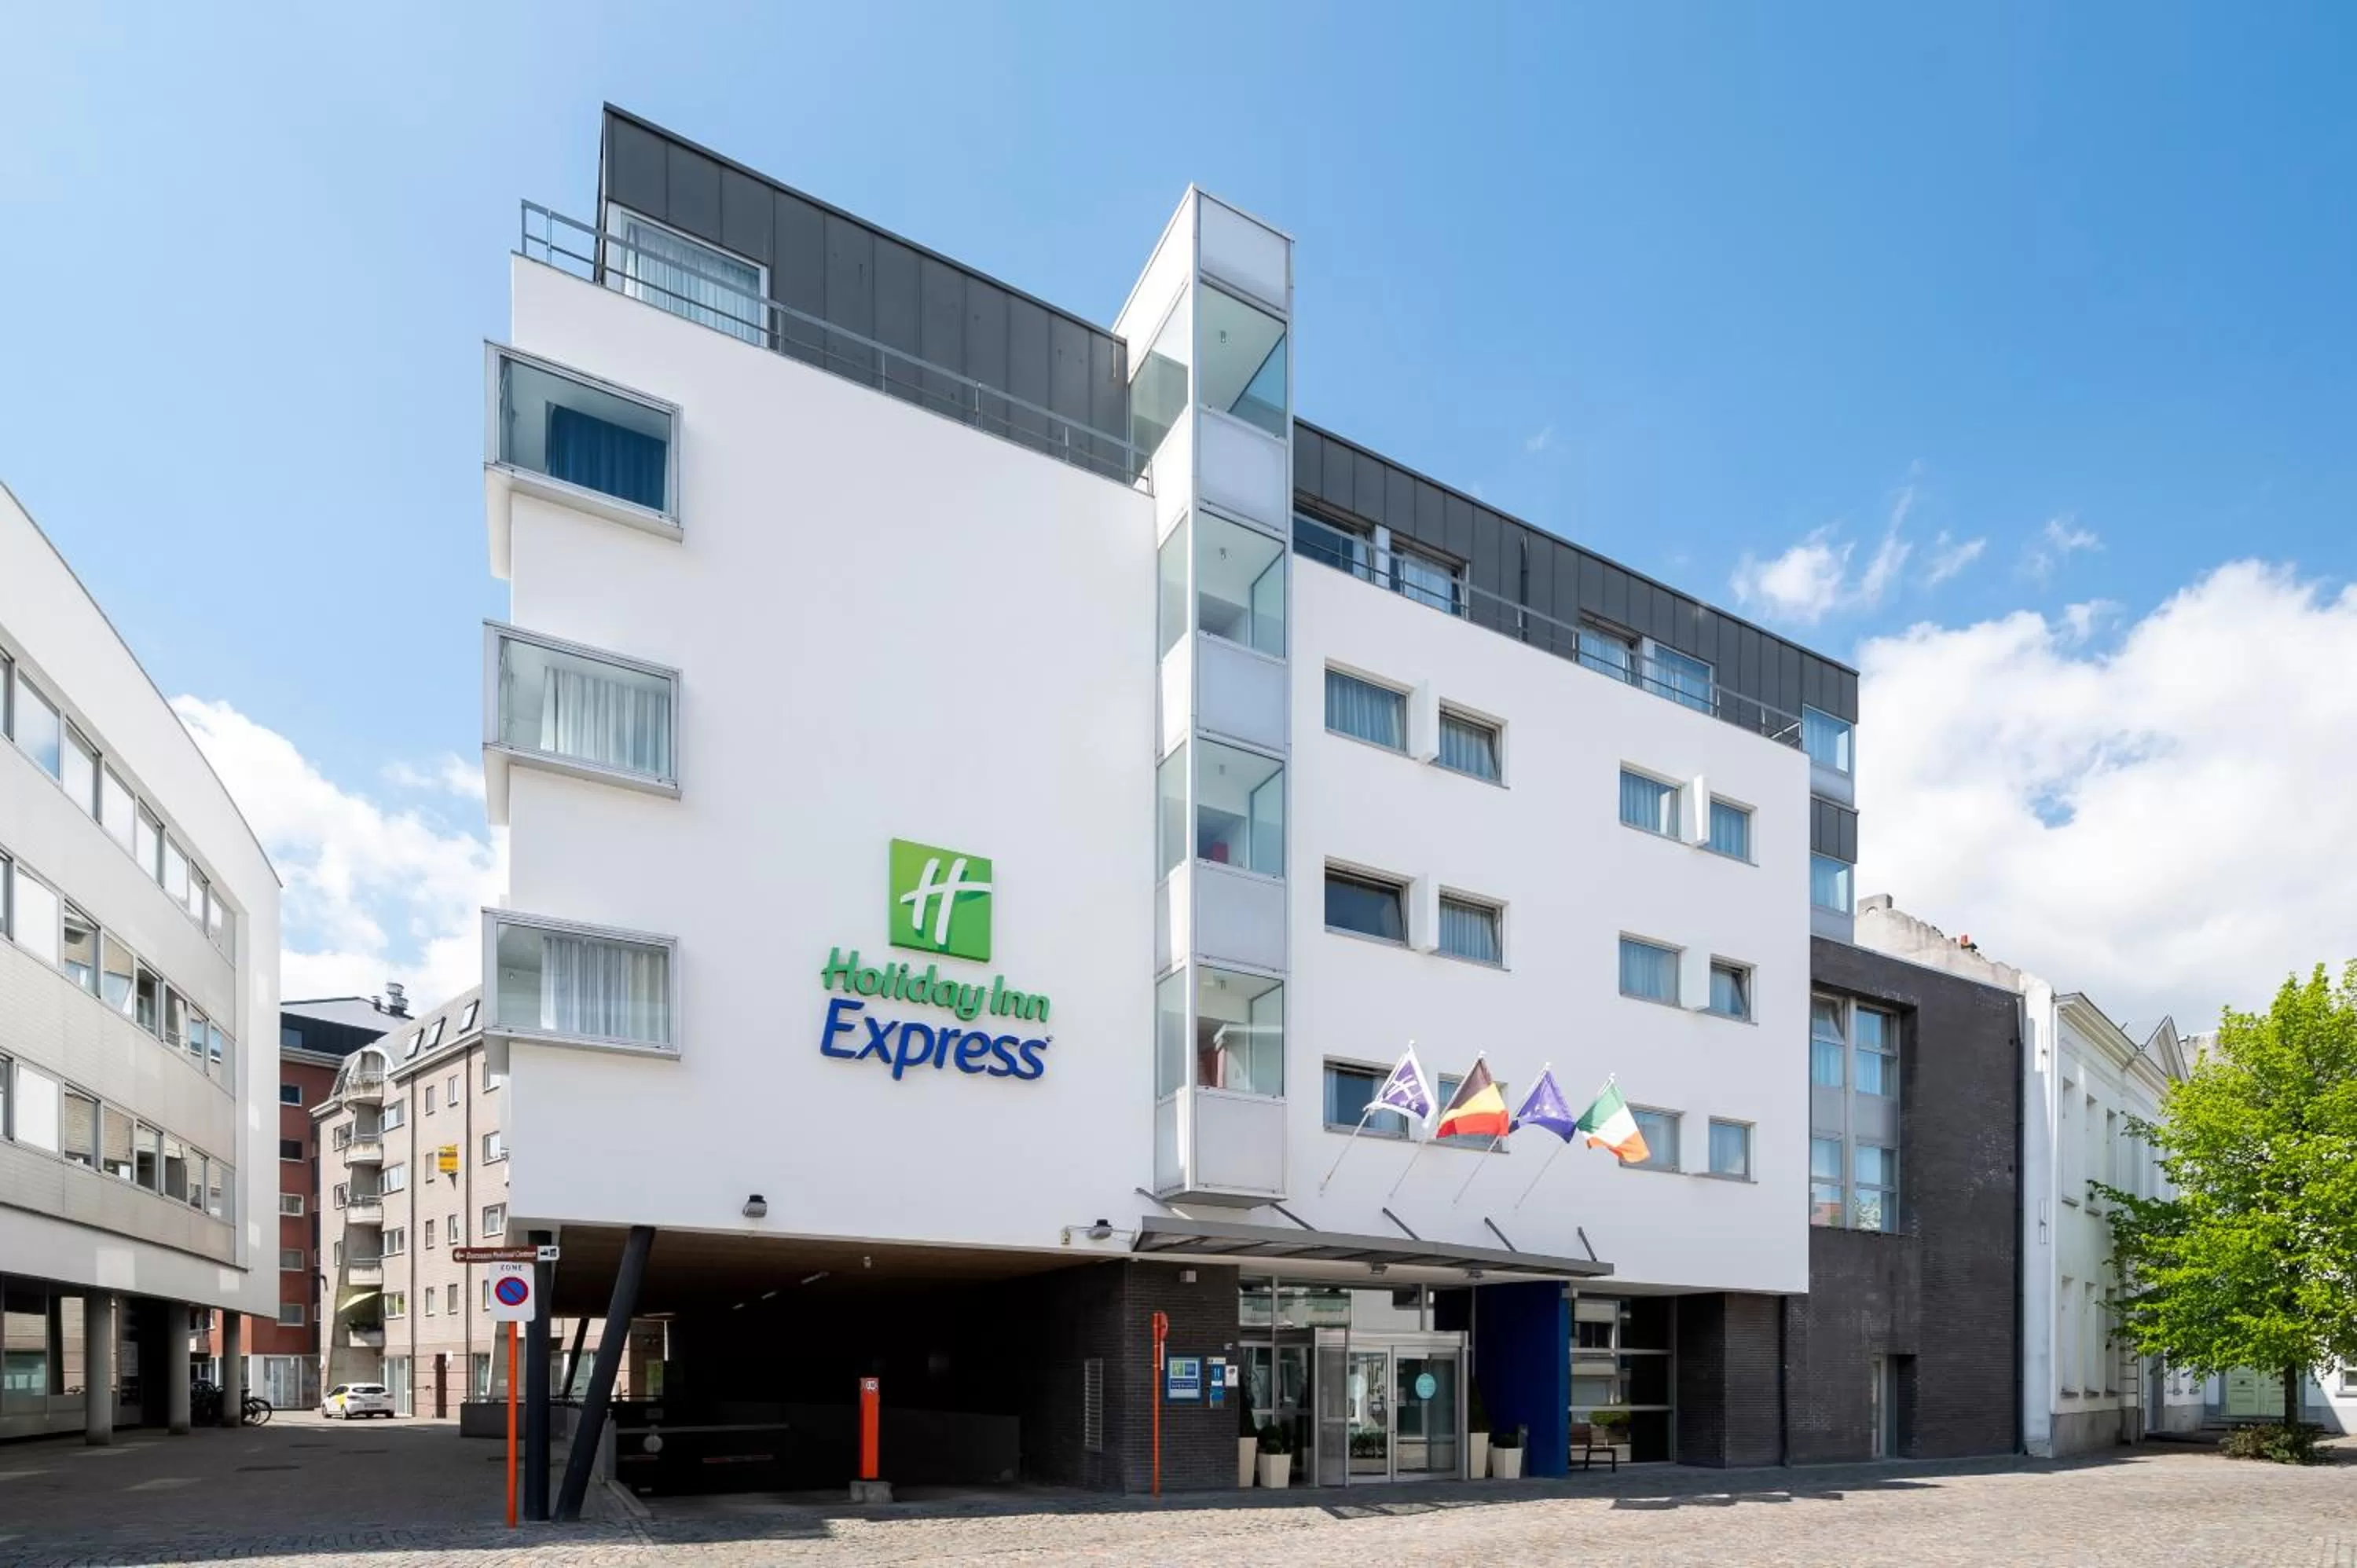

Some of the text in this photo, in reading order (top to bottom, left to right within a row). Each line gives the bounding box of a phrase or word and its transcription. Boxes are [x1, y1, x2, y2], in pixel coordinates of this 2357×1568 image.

[821, 946, 1051, 1023] Holiday Inn
[819, 997, 1048, 1081] Express
